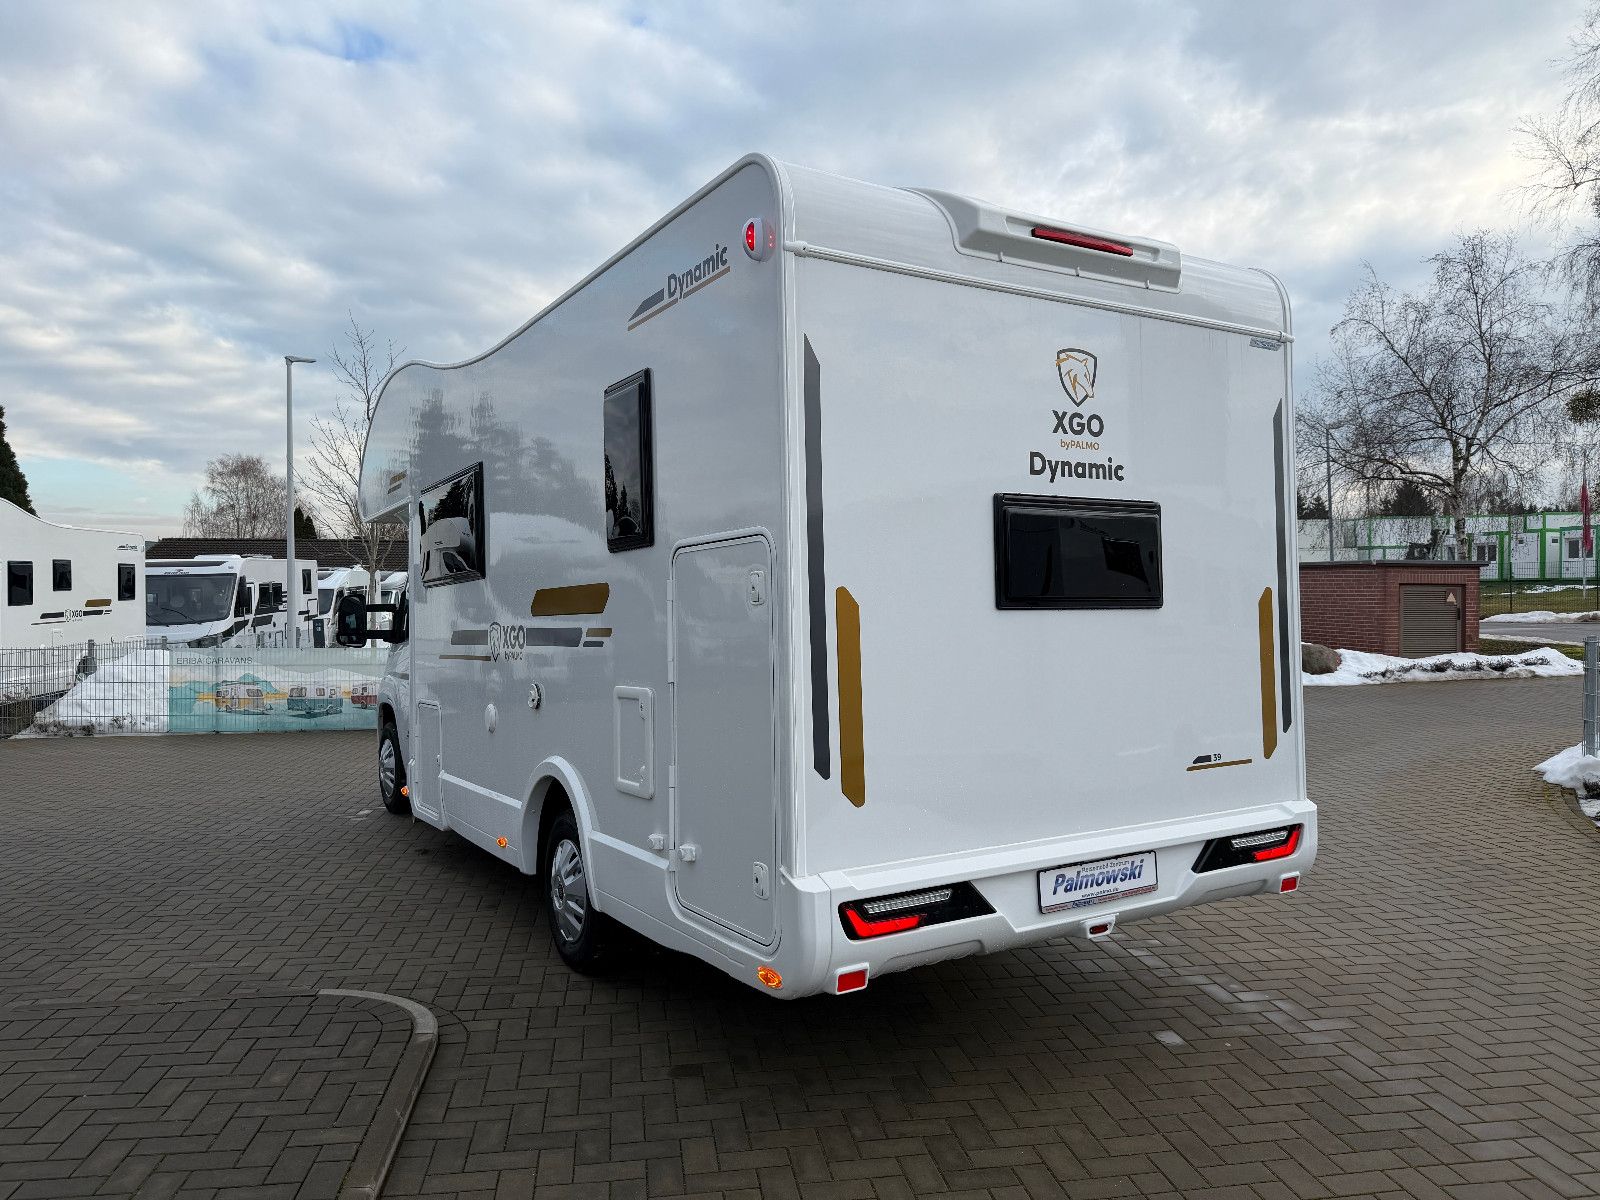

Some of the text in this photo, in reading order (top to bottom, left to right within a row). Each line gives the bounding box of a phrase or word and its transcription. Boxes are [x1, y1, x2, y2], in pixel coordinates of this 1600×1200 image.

[667, 243, 728, 300] Dynamic
[1051, 409, 1104, 438] XGO
[1060, 439, 1100, 451] byPALMO
[1029, 451, 1125, 484] Dynamic
[502, 624, 526, 650] XGO
[176, 656, 253, 665] ERIBA CARAVANS
[1212, 753, 1222, 762] 39
[1052, 859, 1145, 895] Palmowski
